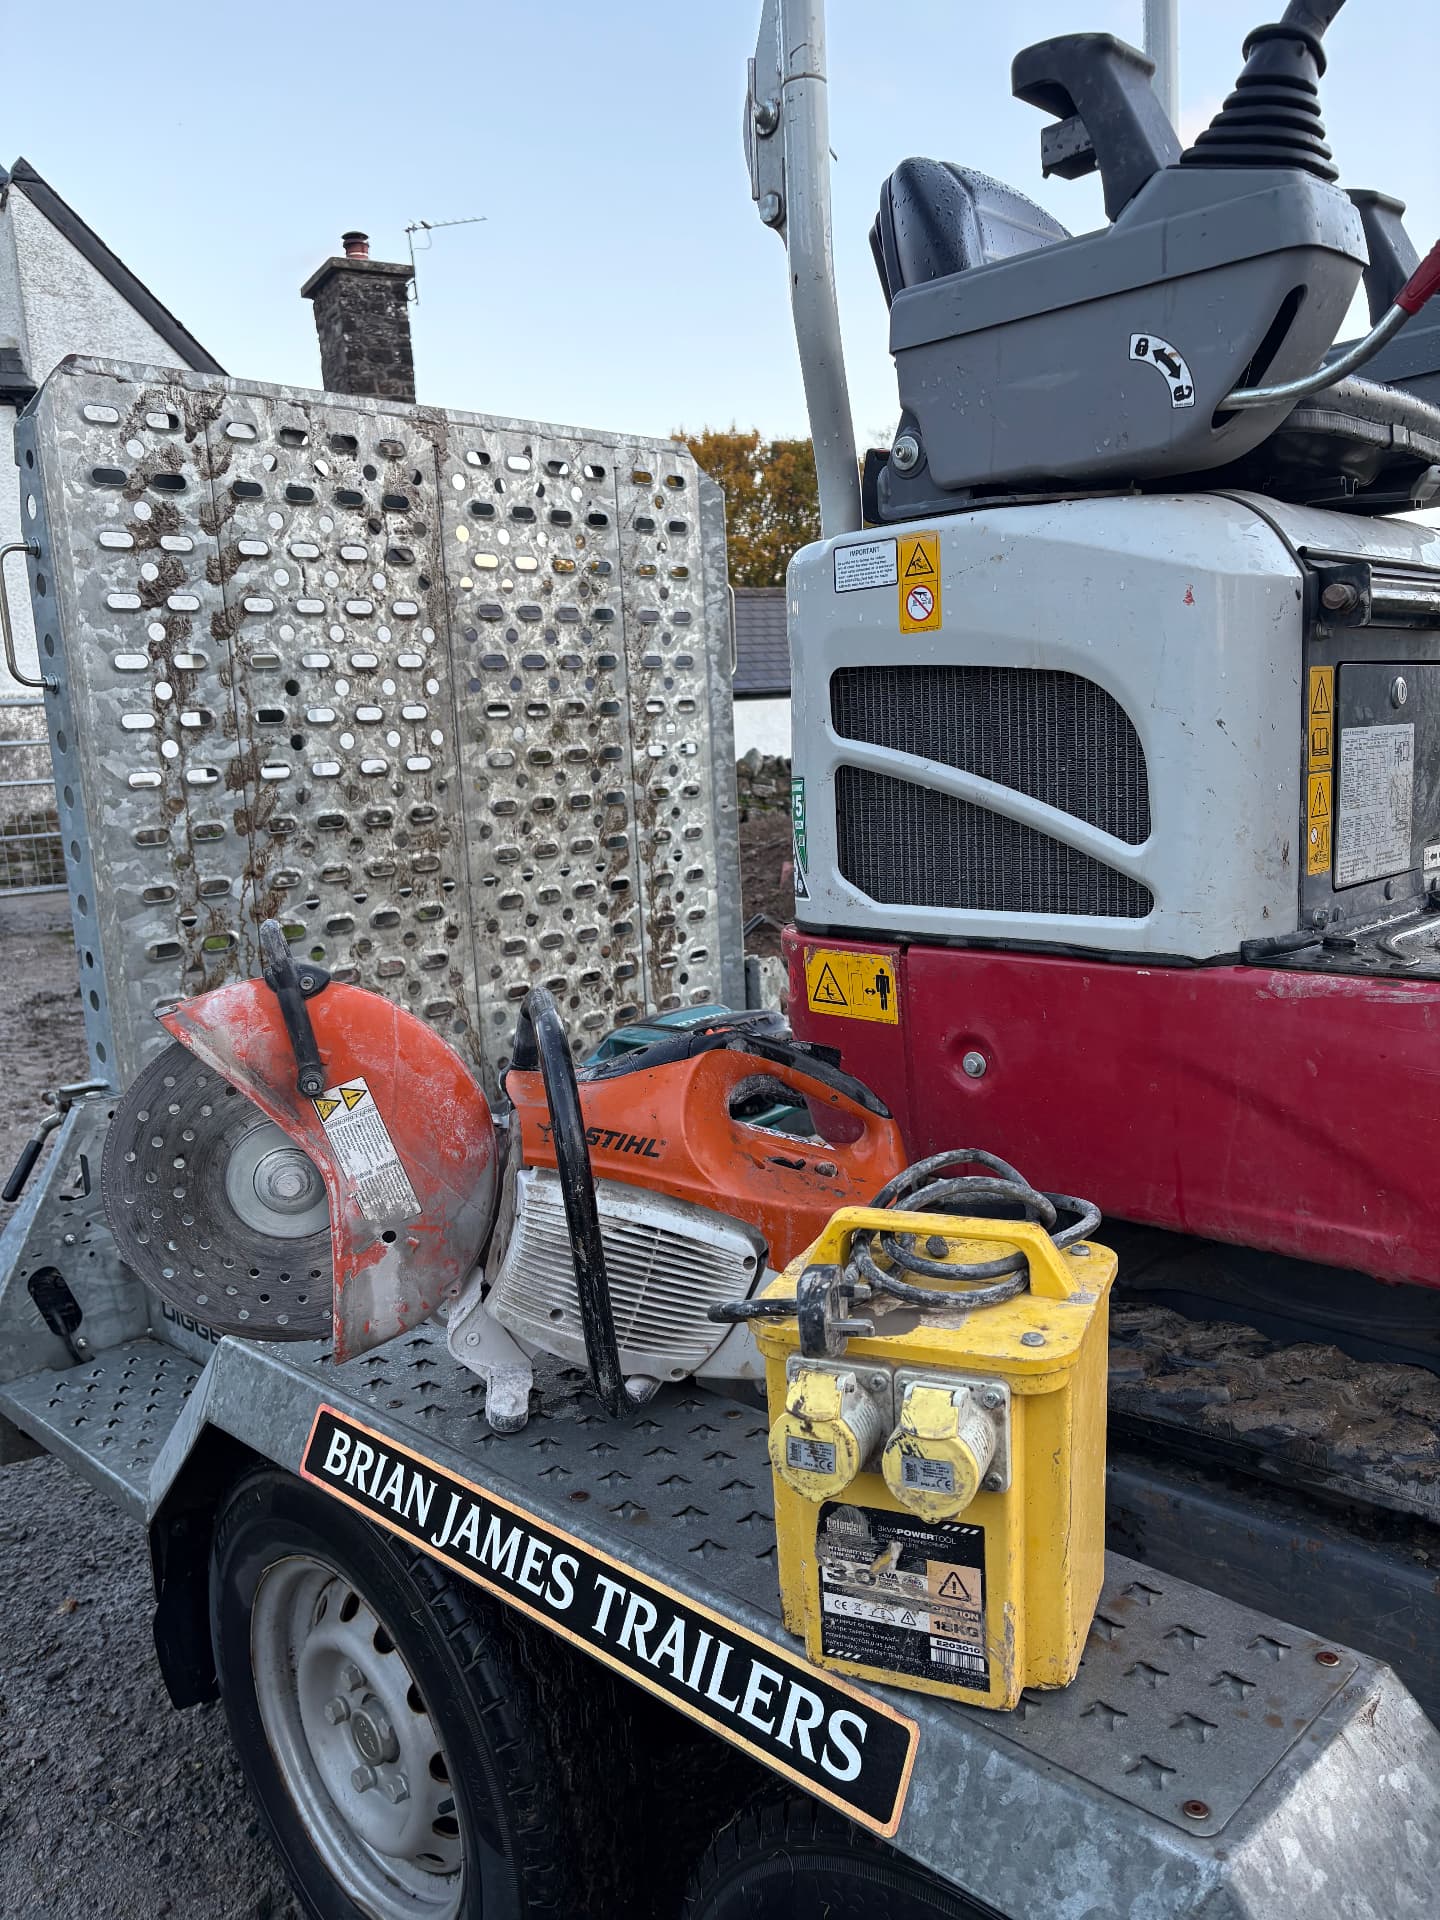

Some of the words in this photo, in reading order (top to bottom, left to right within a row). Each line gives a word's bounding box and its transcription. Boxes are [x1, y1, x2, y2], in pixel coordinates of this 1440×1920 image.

[585, 1126, 661, 1158] STIHL
[322, 1427, 438, 1528] BRIAN
[431, 1491, 580, 1610] JAMES
[591, 1573, 868, 1783] TRAILERS
